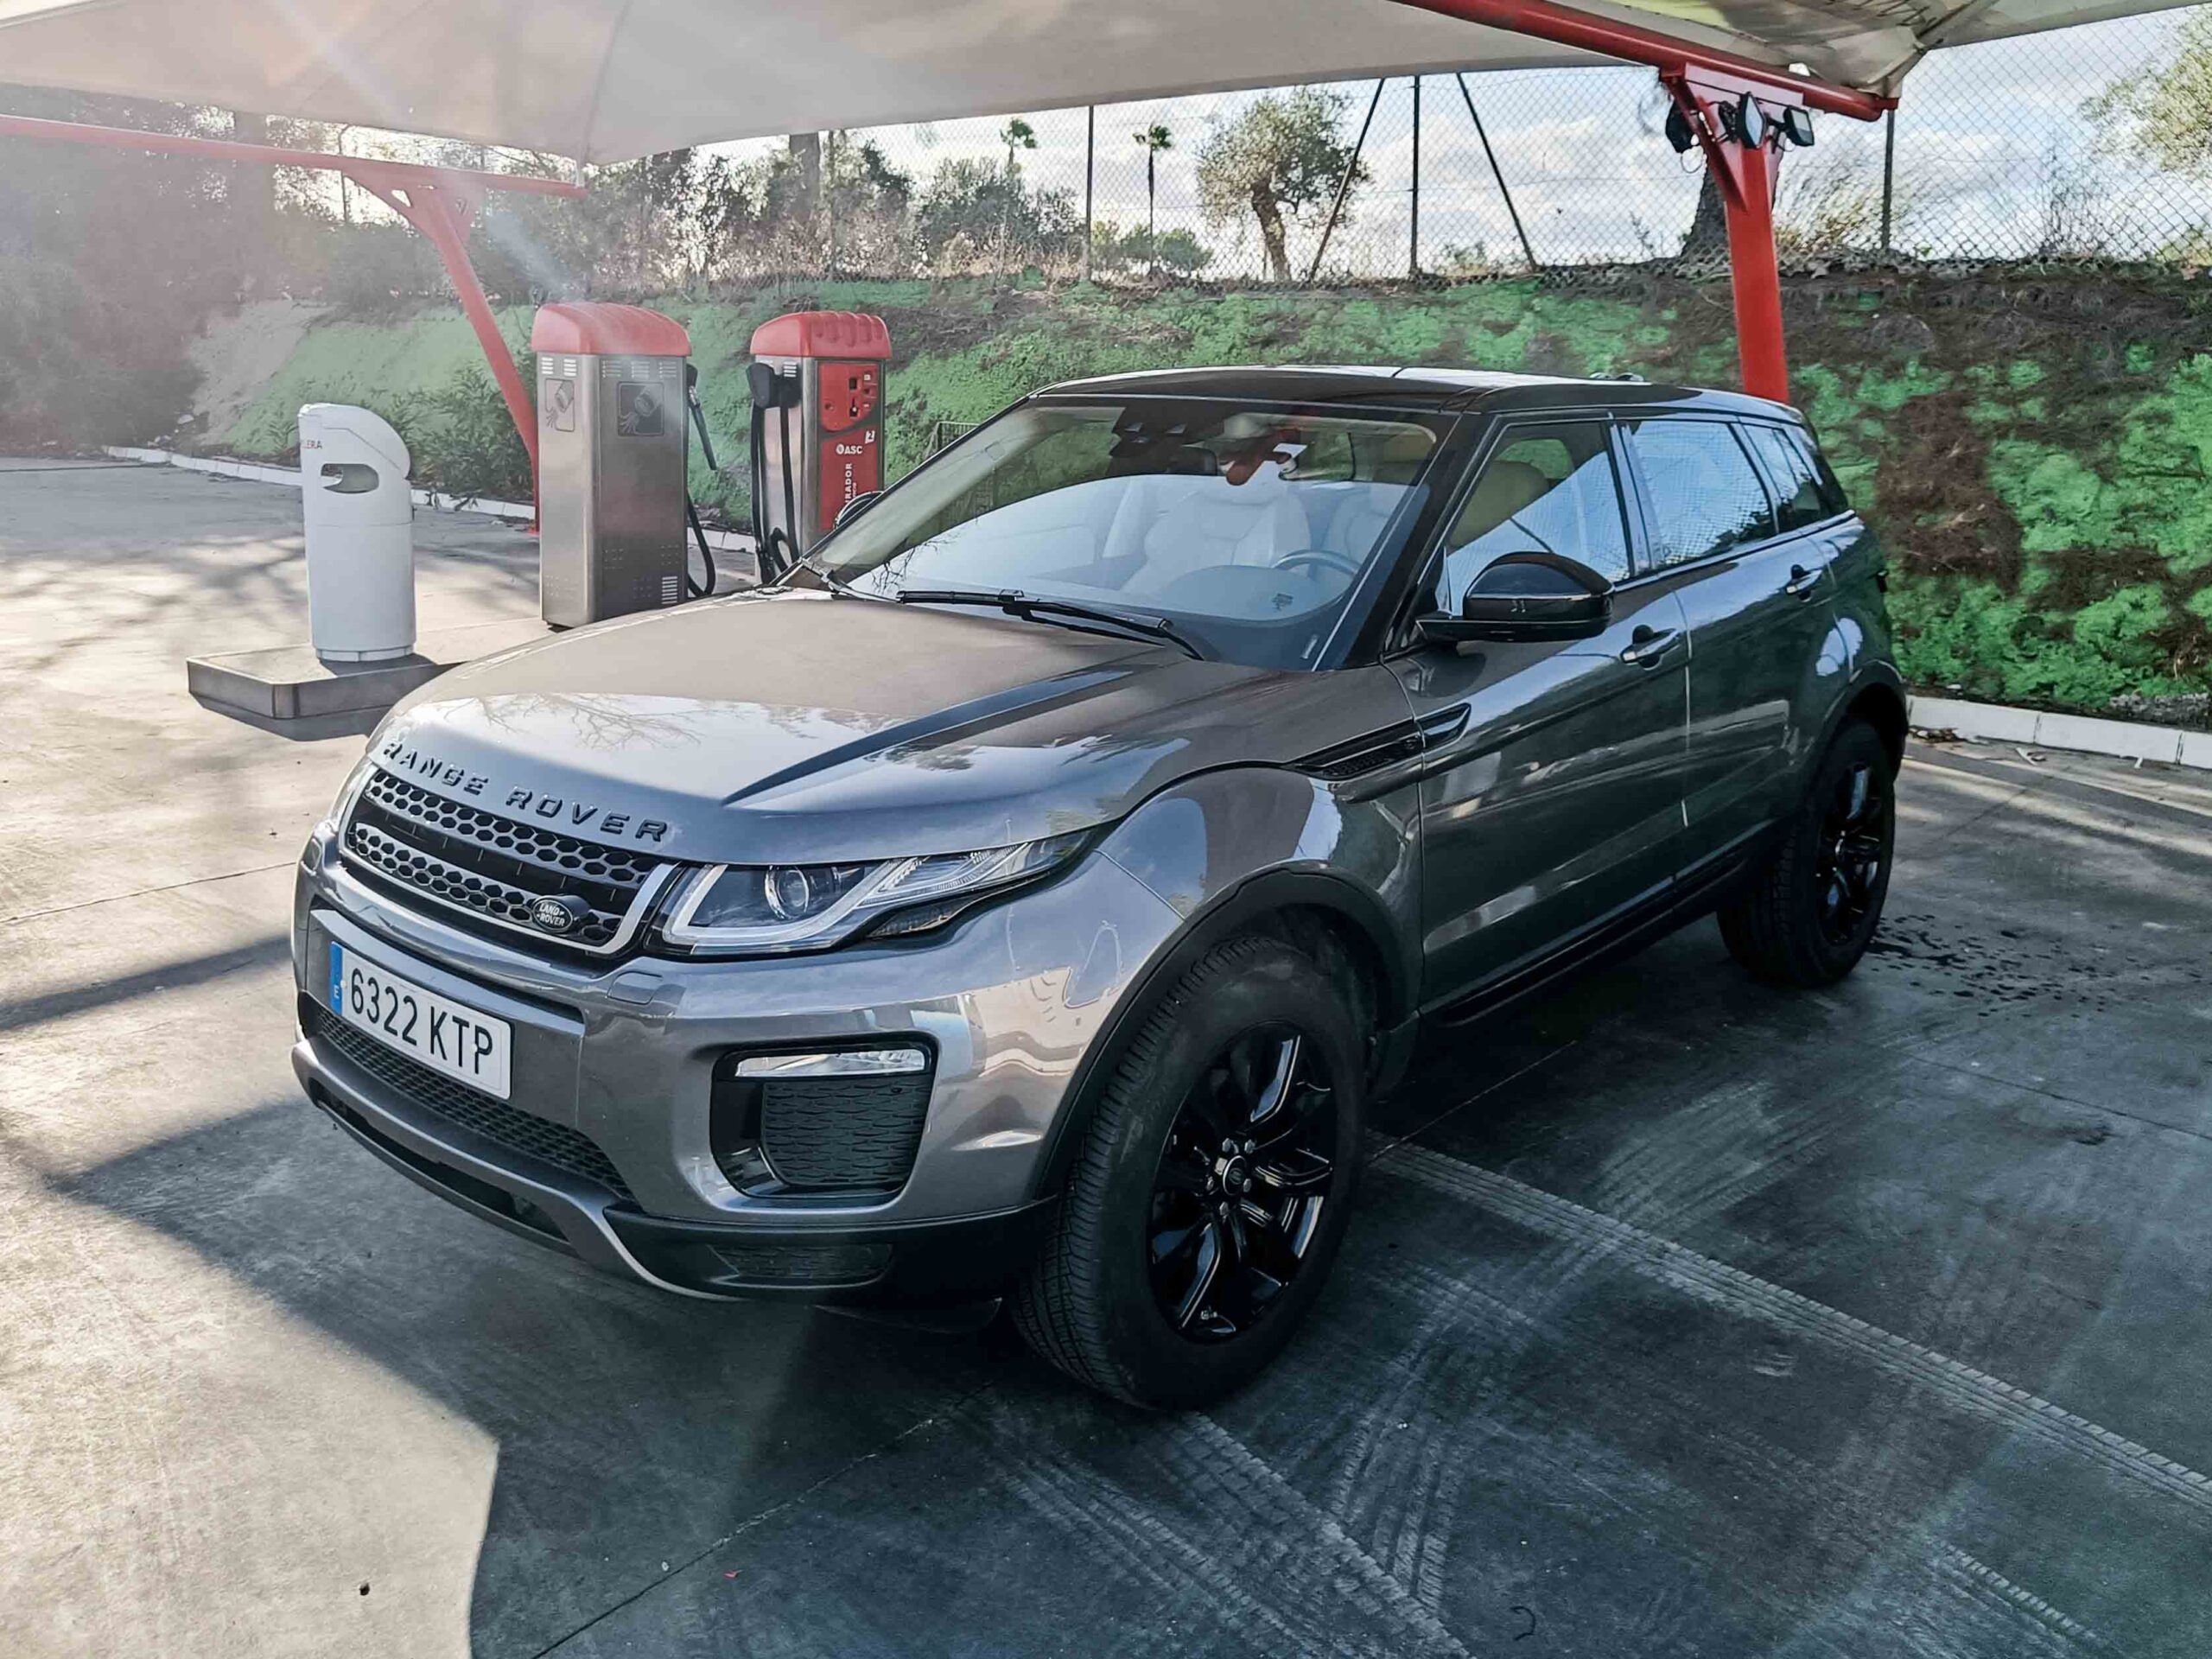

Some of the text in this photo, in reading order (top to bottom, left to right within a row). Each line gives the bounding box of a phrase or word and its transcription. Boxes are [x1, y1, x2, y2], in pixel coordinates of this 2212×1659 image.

[383, 741, 668, 843] RANGE ROVER
[538, 903, 561, 916] LAND
[539, 912, 566, 927] ROVER
[351, 968, 493, 1075] 6322 KTP
